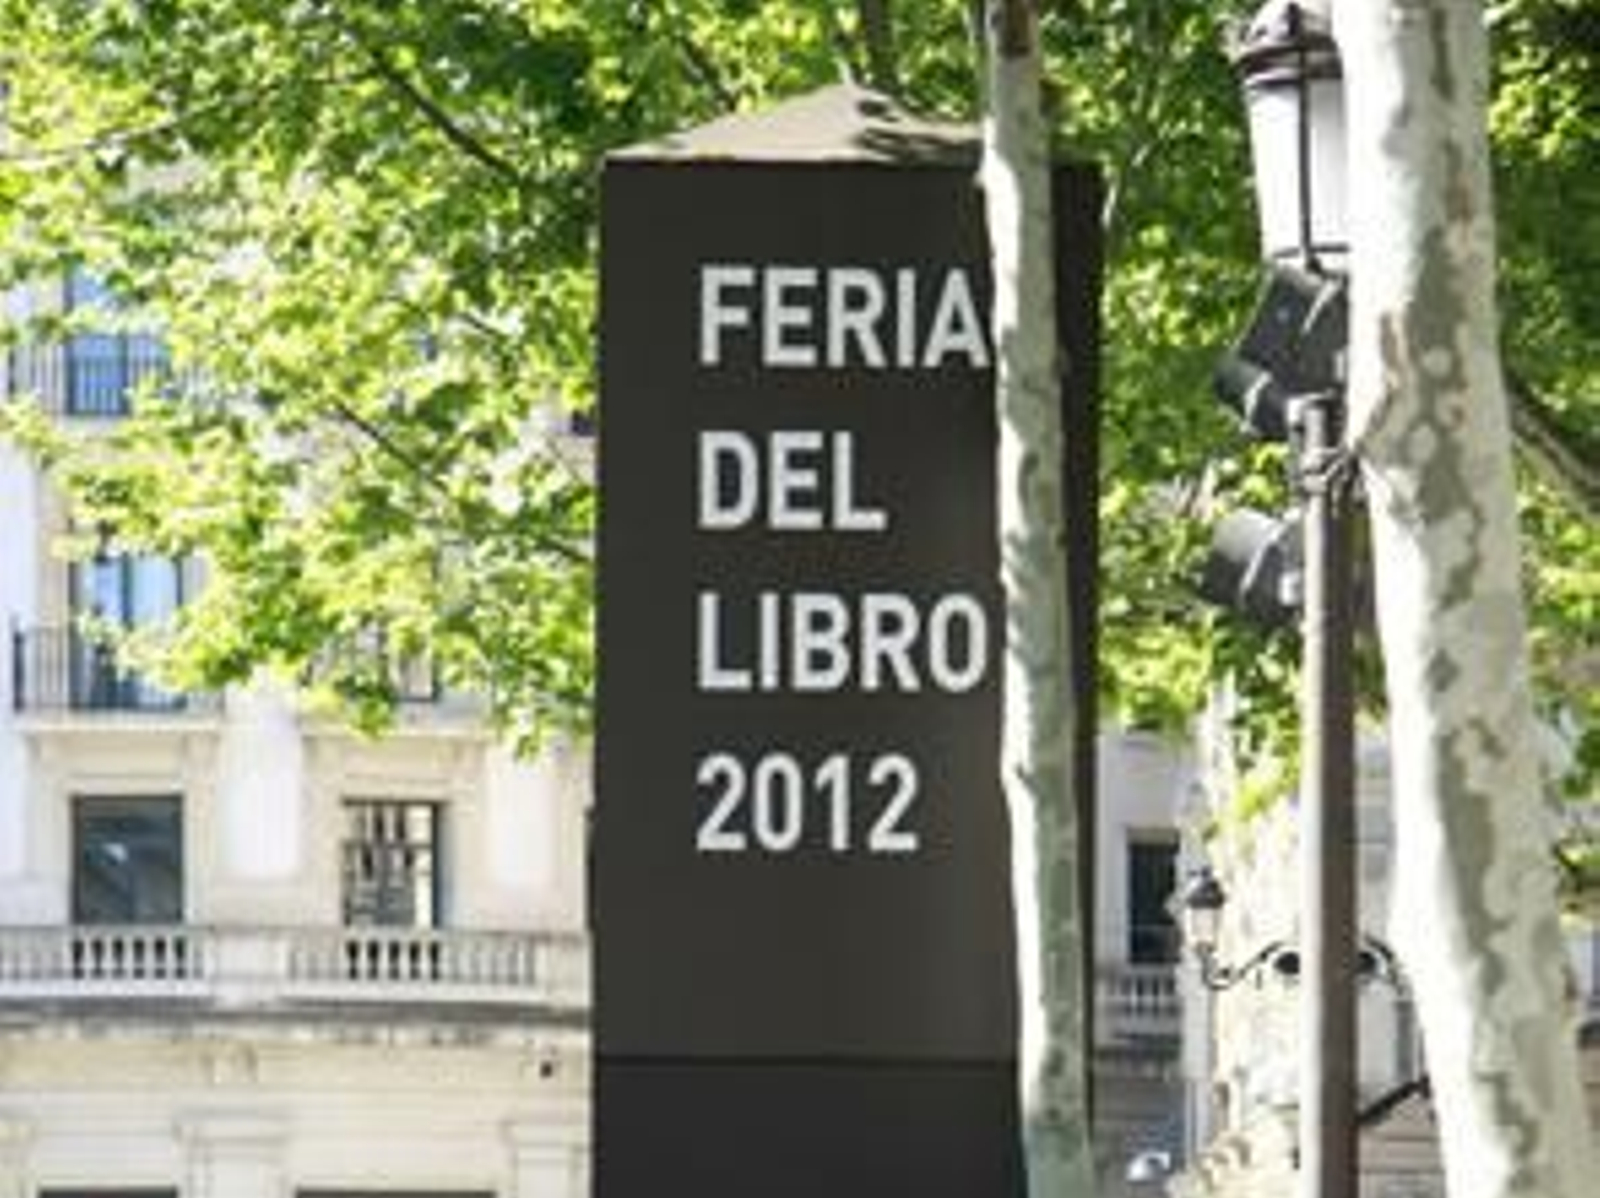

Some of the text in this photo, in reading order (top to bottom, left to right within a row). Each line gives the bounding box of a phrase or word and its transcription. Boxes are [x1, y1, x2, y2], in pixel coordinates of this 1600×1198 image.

[699, 266, 988, 367] FERIA
[698, 430, 887, 531] DEL
[697, 592, 986, 693] LIBRO
[696, 753, 919, 853] 2012
